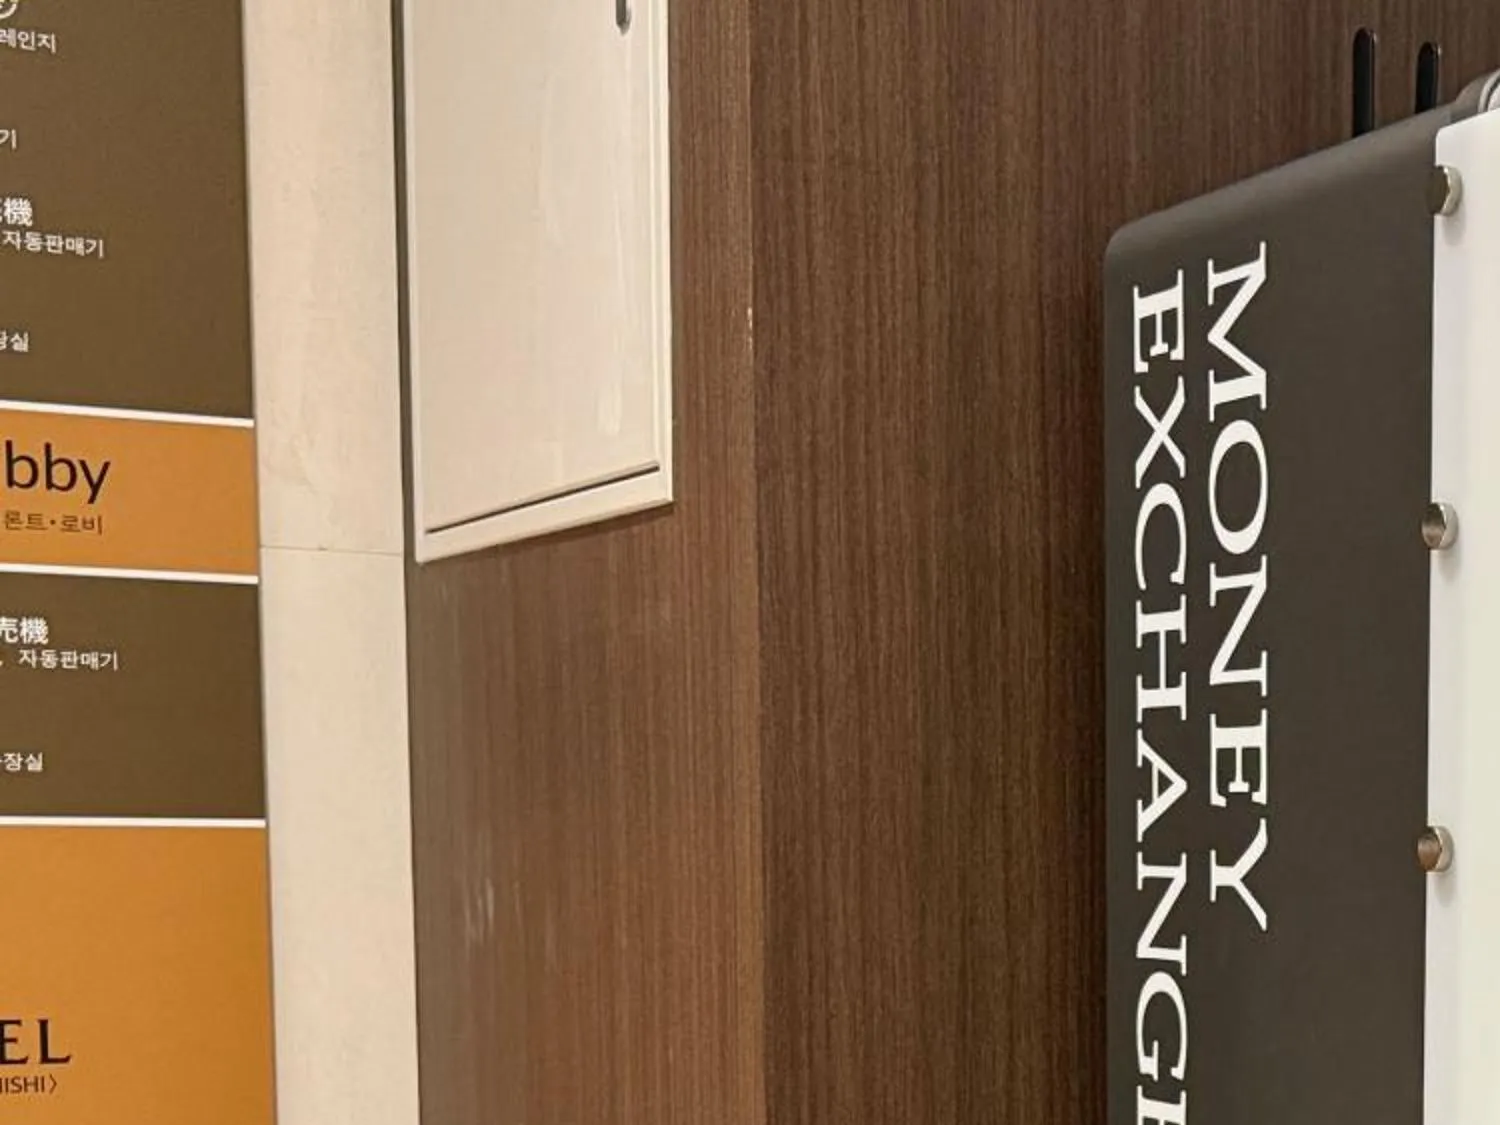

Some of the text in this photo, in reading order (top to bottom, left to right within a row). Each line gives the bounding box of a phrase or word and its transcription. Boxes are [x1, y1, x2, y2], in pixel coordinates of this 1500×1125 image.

[0, 197, 33, 228] 機
[2, 231, 104, 259] 자동판매기
[5, 440, 111, 504] bby
[1207, 241, 1268, 931] MONEY
[19, 649, 118, 672] 자동판매기
[0, 752, 43, 772] 장실
